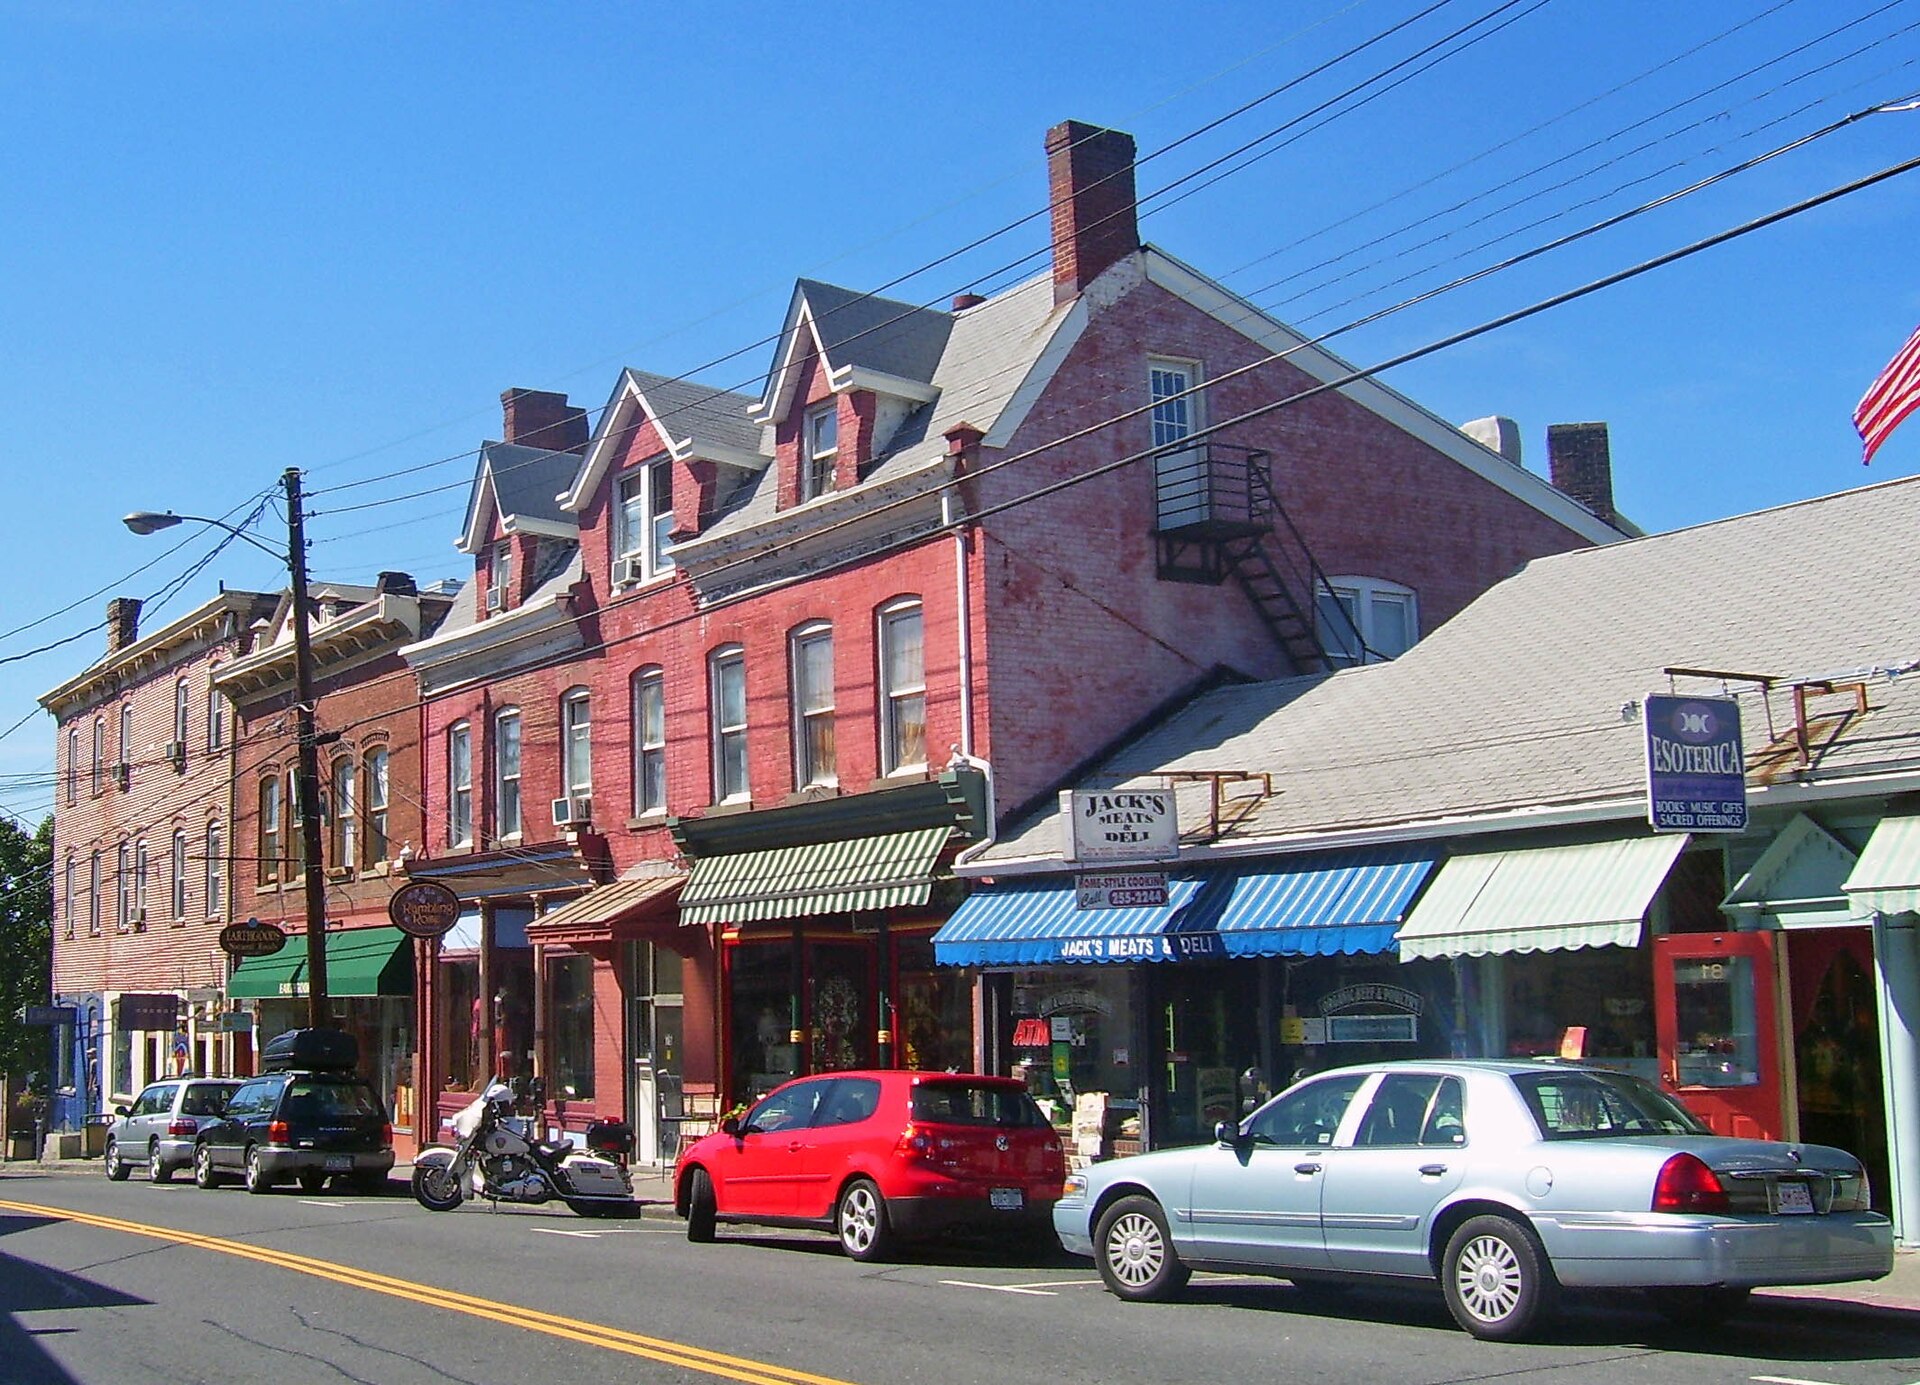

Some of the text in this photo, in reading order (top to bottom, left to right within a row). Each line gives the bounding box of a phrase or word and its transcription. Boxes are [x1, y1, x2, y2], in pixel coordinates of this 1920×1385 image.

[1651, 735, 1742, 774] ESOTERICA
[1085, 794, 1165, 817] JACK'S
[1656, 801, 1744, 814] BOOKS MUSIC GIFTS
[1098, 812, 1154, 825] MEATS
[1660, 813, 1741, 826] SACRED OFFERINGS
[1104, 831, 1150, 842] DELI
[1081, 890, 1161, 907] Call 255-2244
[403, 902, 454, 915] Rambling
[1061, 936, 1213, 956] JACK'S MEATS & DELI
[1012, 1019, 1050, 1046] ATM
